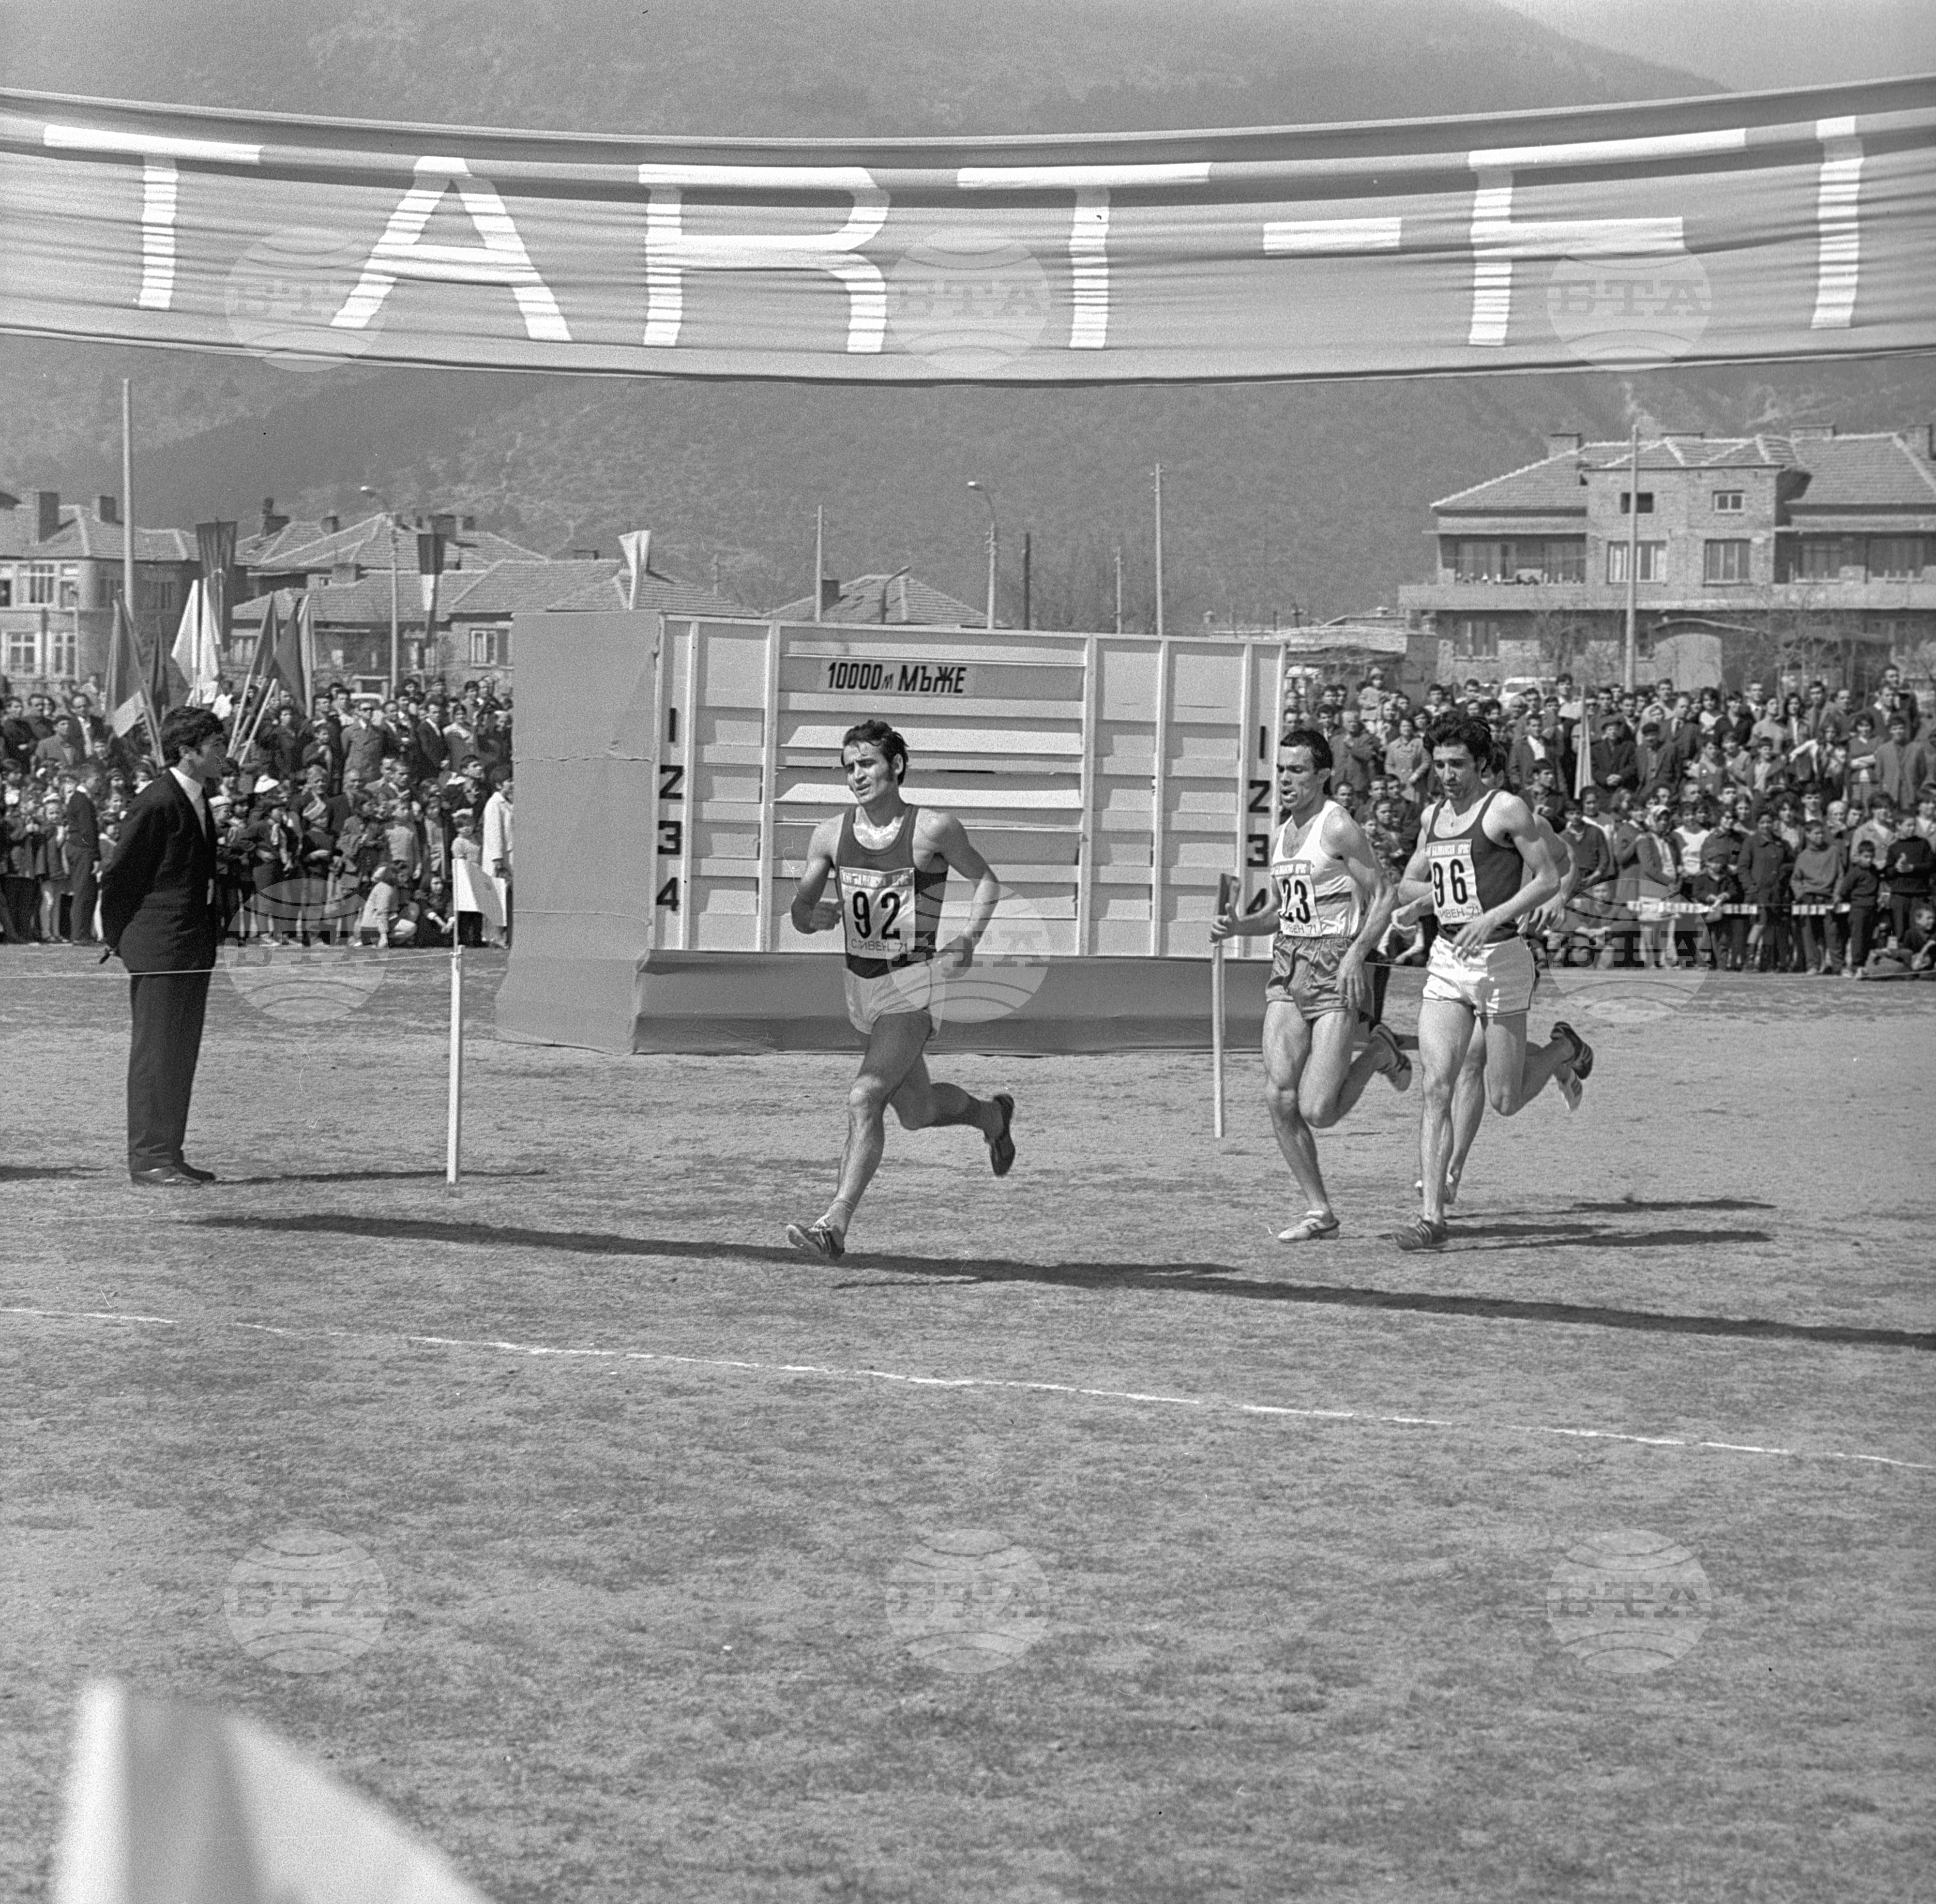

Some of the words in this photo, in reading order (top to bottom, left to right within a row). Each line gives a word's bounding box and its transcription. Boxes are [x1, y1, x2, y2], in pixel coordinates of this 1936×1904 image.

[658, 821, 681, 855] 3
[1247, 833, 1269, 868] 3
[656, 877, 680, 912] 4
[1433, 859, 1468, 908] 96
[853, 891, 901, 939] 92
[1246, 888, 1267, 915] 4
[1282, 879, 1311, 924] 23
